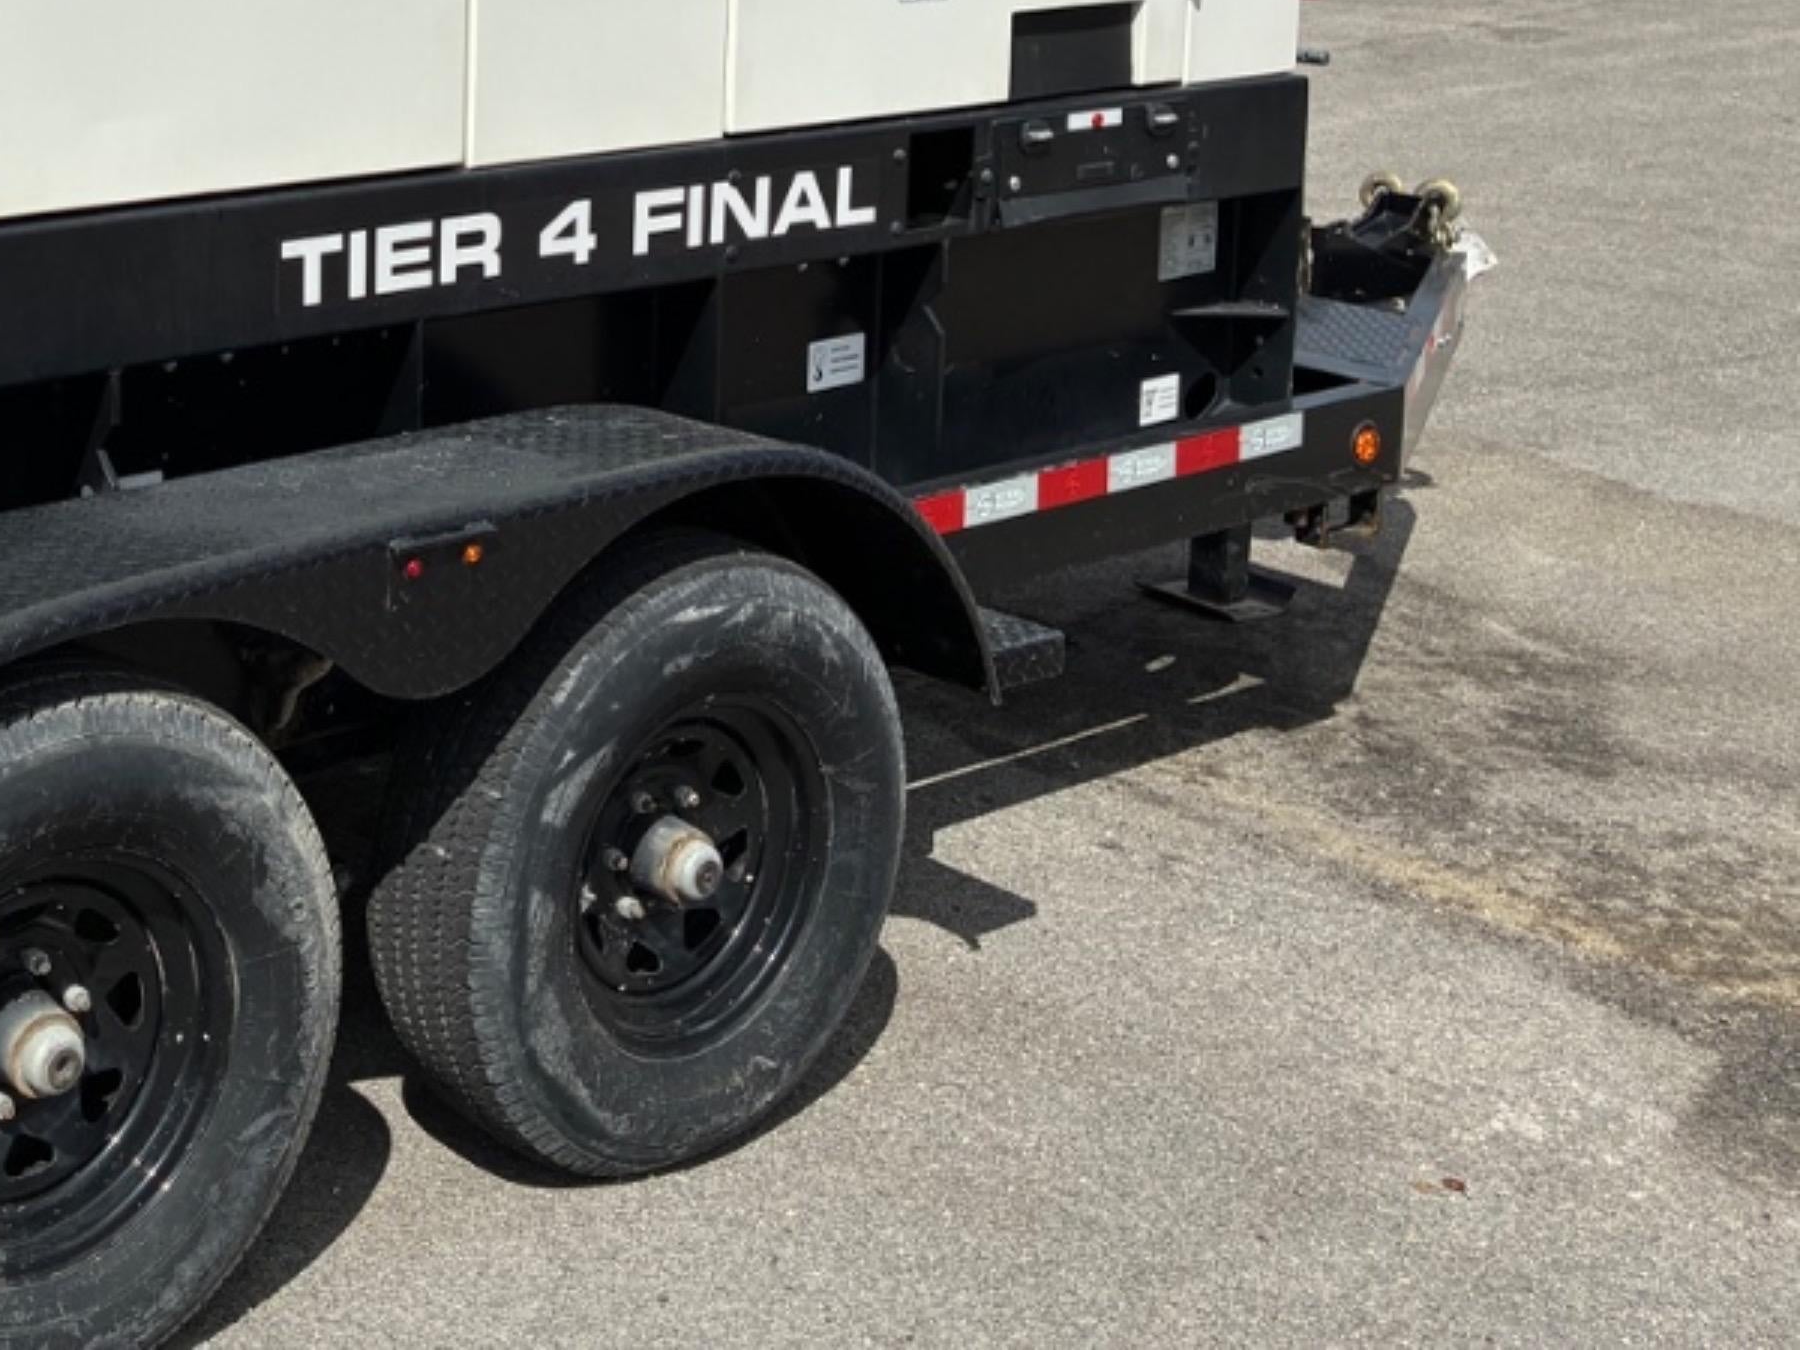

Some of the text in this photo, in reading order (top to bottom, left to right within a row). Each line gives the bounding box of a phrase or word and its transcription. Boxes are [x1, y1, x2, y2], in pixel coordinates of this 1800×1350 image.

[281, 166, 877, 307] TIER 4 FINAL
